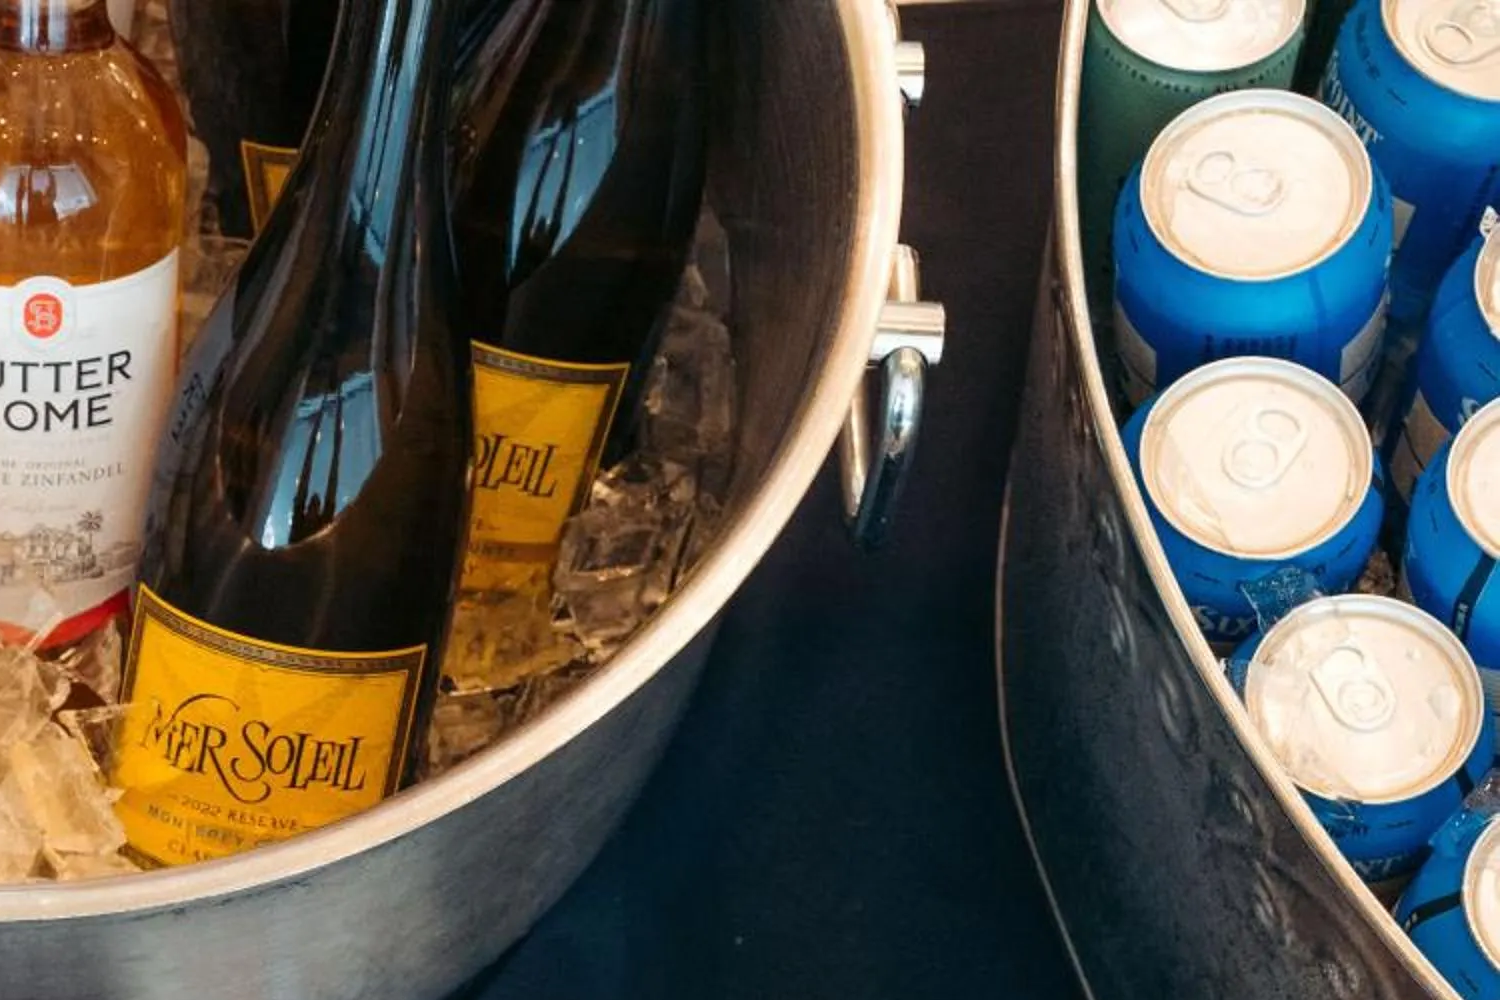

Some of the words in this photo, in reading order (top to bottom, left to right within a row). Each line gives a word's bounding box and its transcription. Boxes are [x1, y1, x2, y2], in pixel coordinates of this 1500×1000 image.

[20, 461, 128, 488] ZINFANDEL
[139, 693, 271, 804] MER
[230, 720, 369, 793] SOLEIL
[181, 795, 221, 818] 2022
